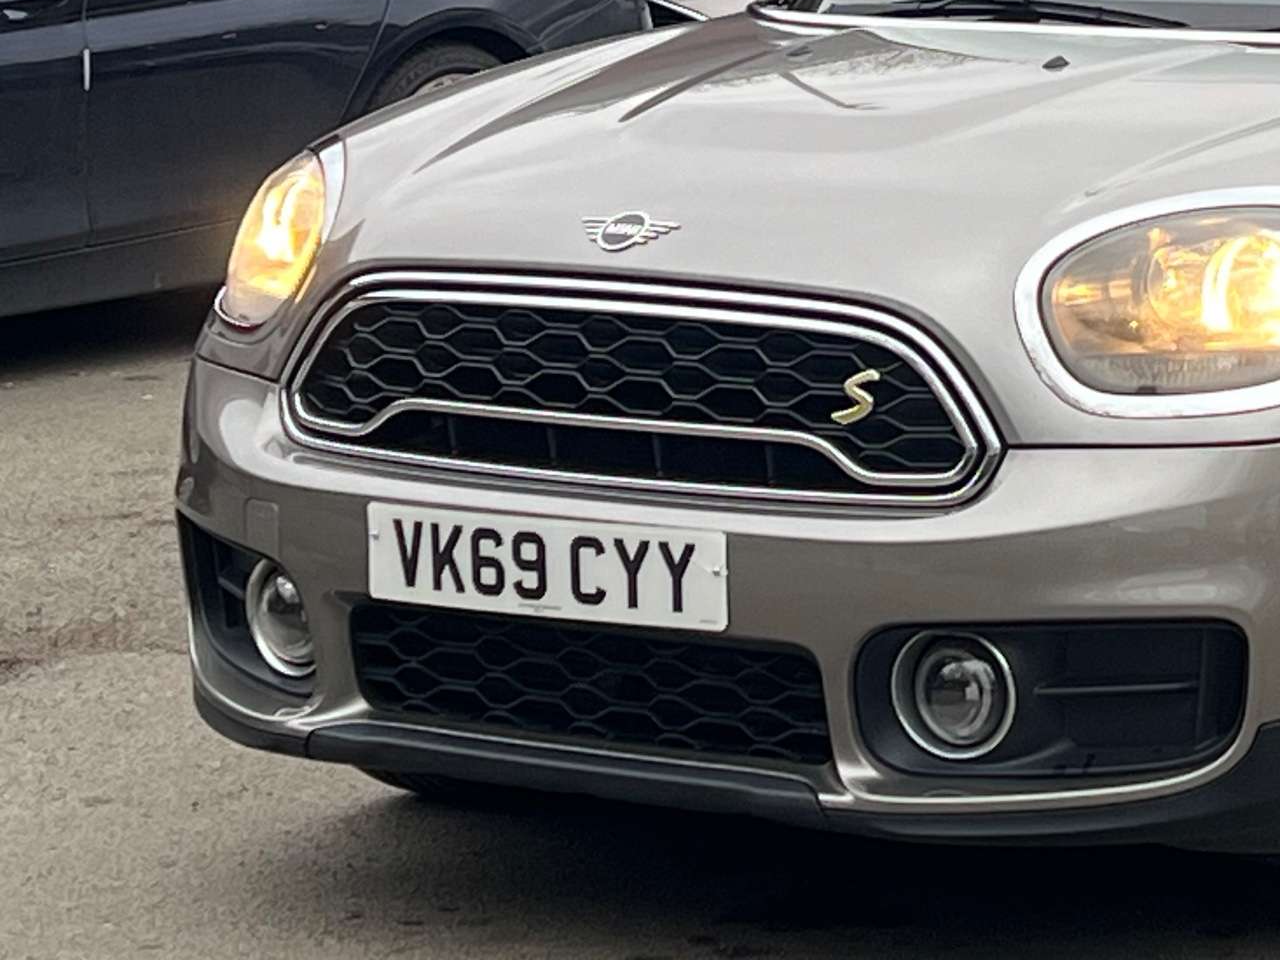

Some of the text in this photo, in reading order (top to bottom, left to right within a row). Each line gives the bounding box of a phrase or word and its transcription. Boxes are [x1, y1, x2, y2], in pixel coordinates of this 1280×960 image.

[831, 369, 880, 425] S
[393, 518, 696, 613] VK69 CYY
